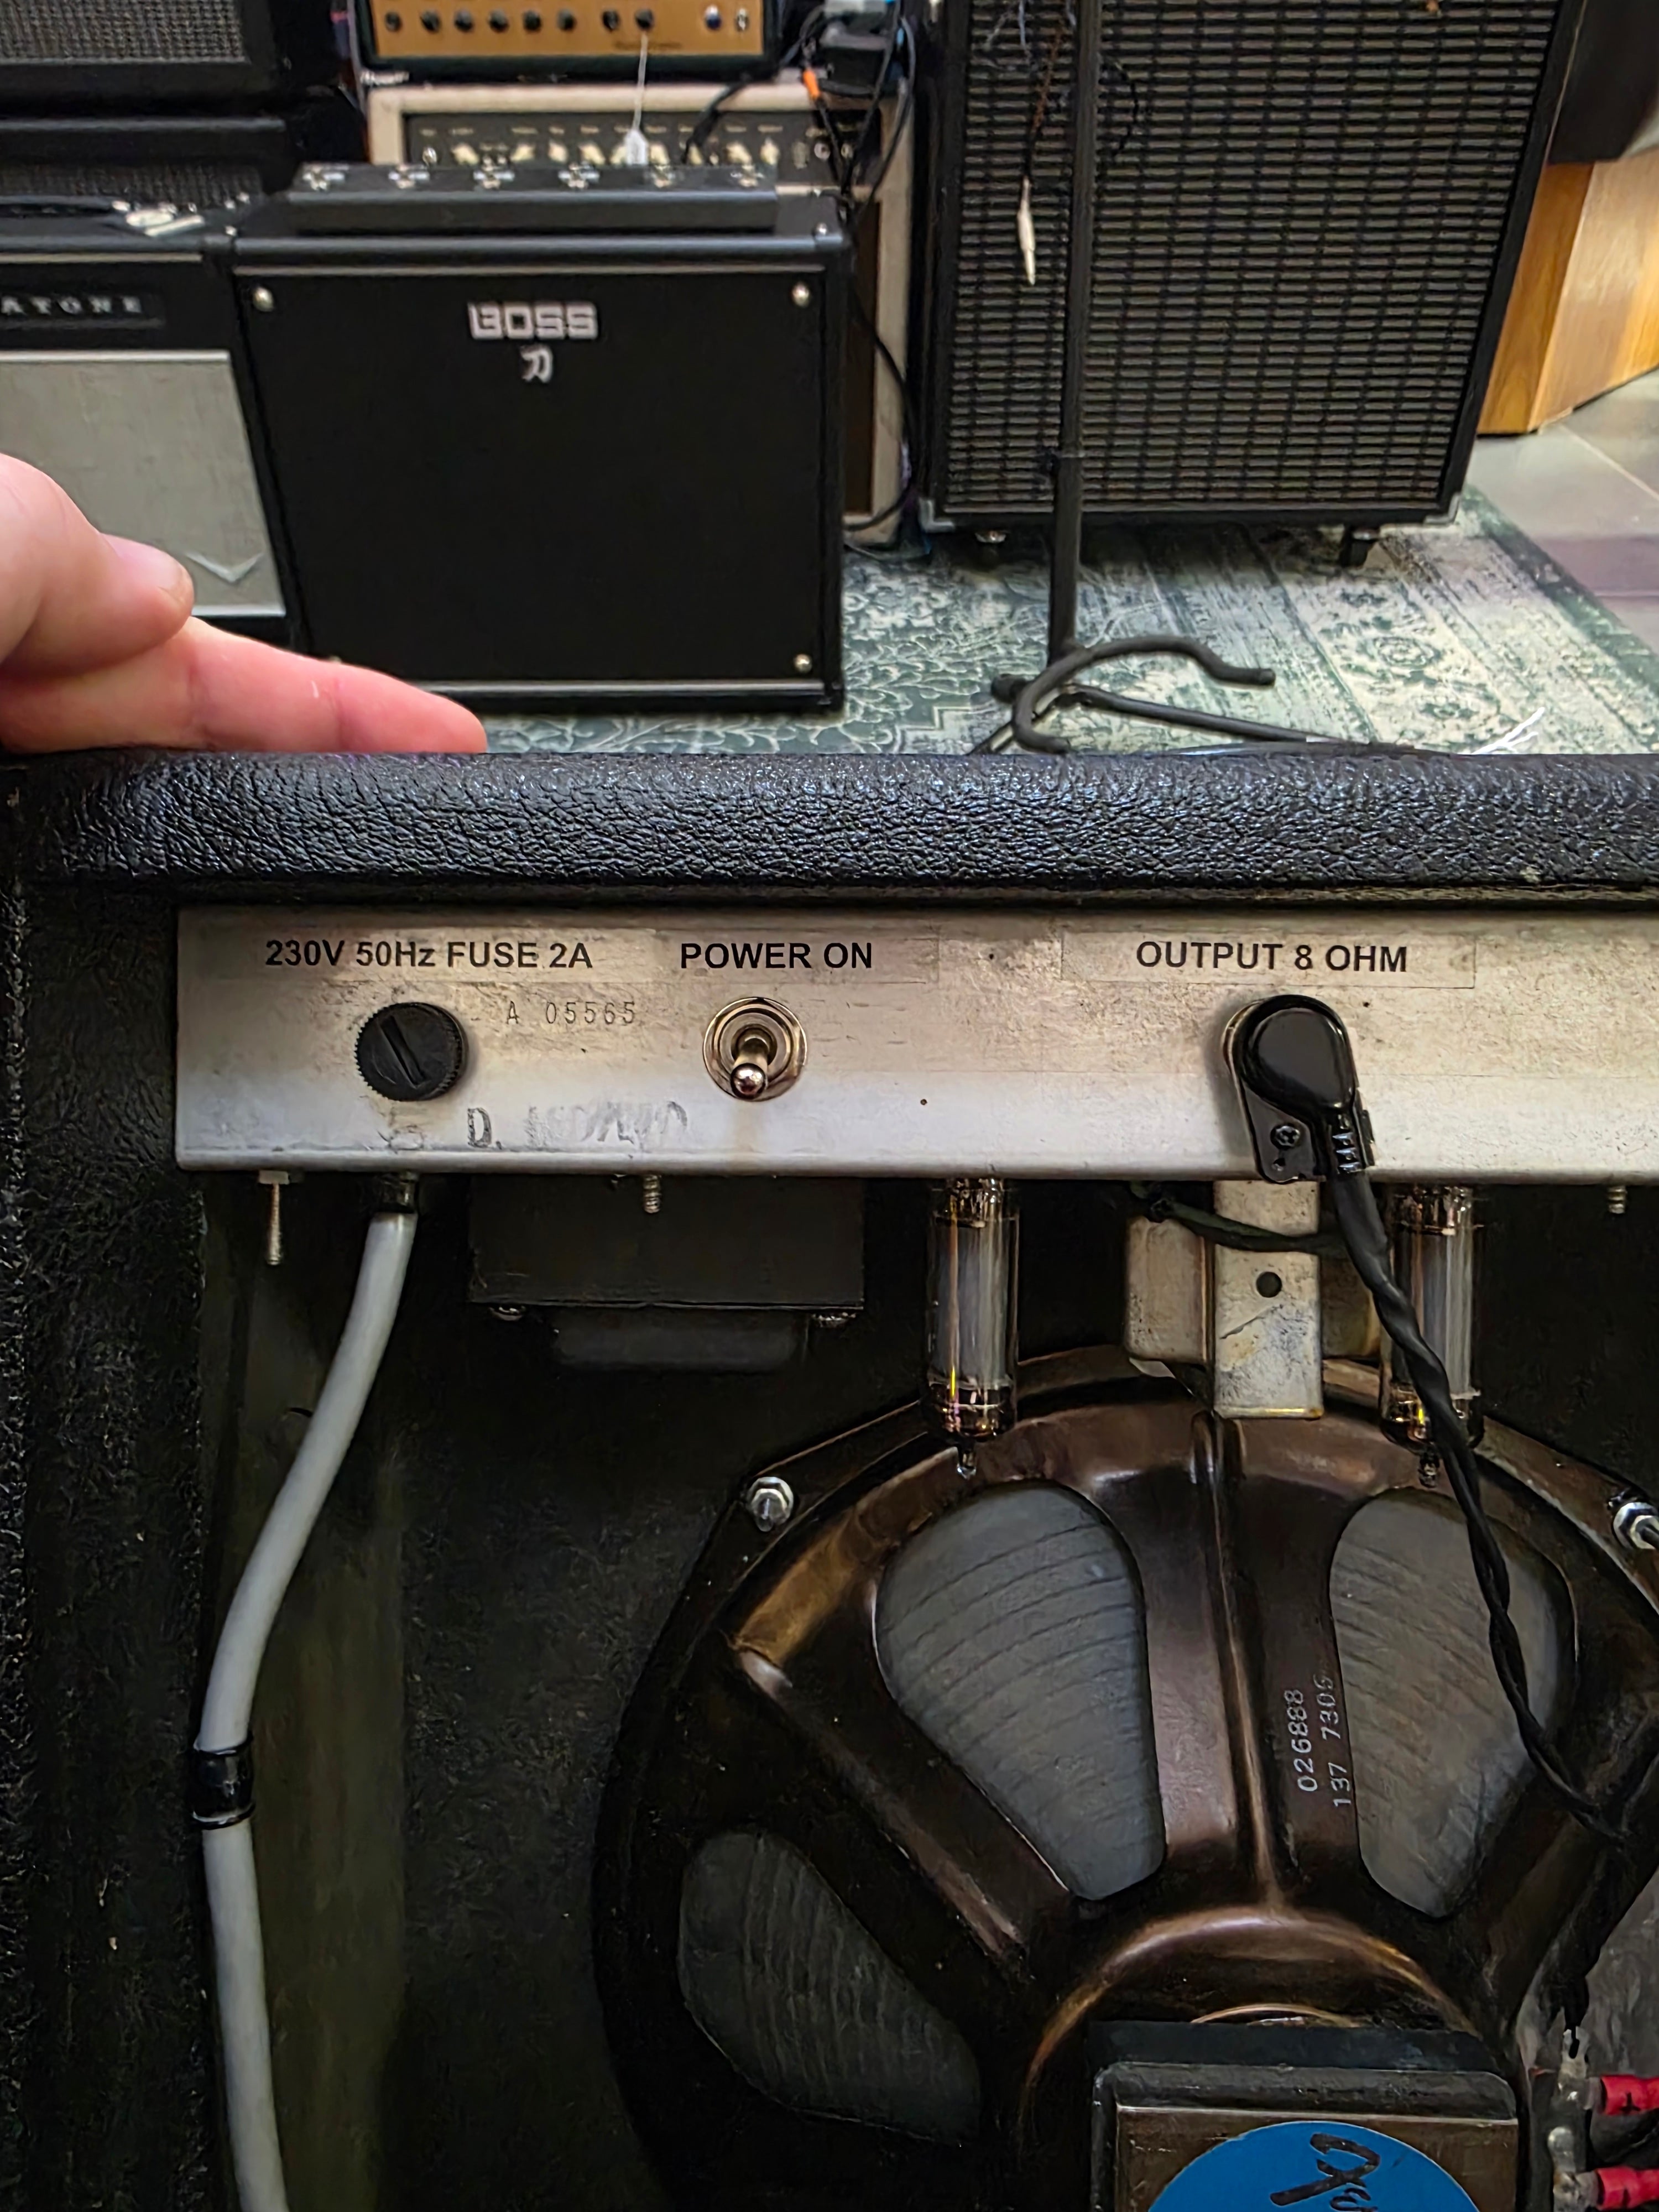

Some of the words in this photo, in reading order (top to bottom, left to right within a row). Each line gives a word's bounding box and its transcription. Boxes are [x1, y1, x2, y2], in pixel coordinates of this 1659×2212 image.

[468, 301, 598, 340] BOSS
[265, 940, 346, 967] 230V
[356, 941, 436, 967] 50Hz
[447, 941, 538, 968] FUSE
[549, 942, 593, 969] 2A
[681, 942, 812, 969] POWER
[823, 942, 872, 969] ON
[1136, 941, 1284, 970] OUTPUT
[1294, 944, 1313, 971] 8
[1325, 945, 1407, 972] OHM
[507, 1000, 519, 1024] A
[545, 1001, 635, 1024] 05565
[1284, 1689, 1318, 1792] 026888
[1328, 1762, 1352, 1807] 137
